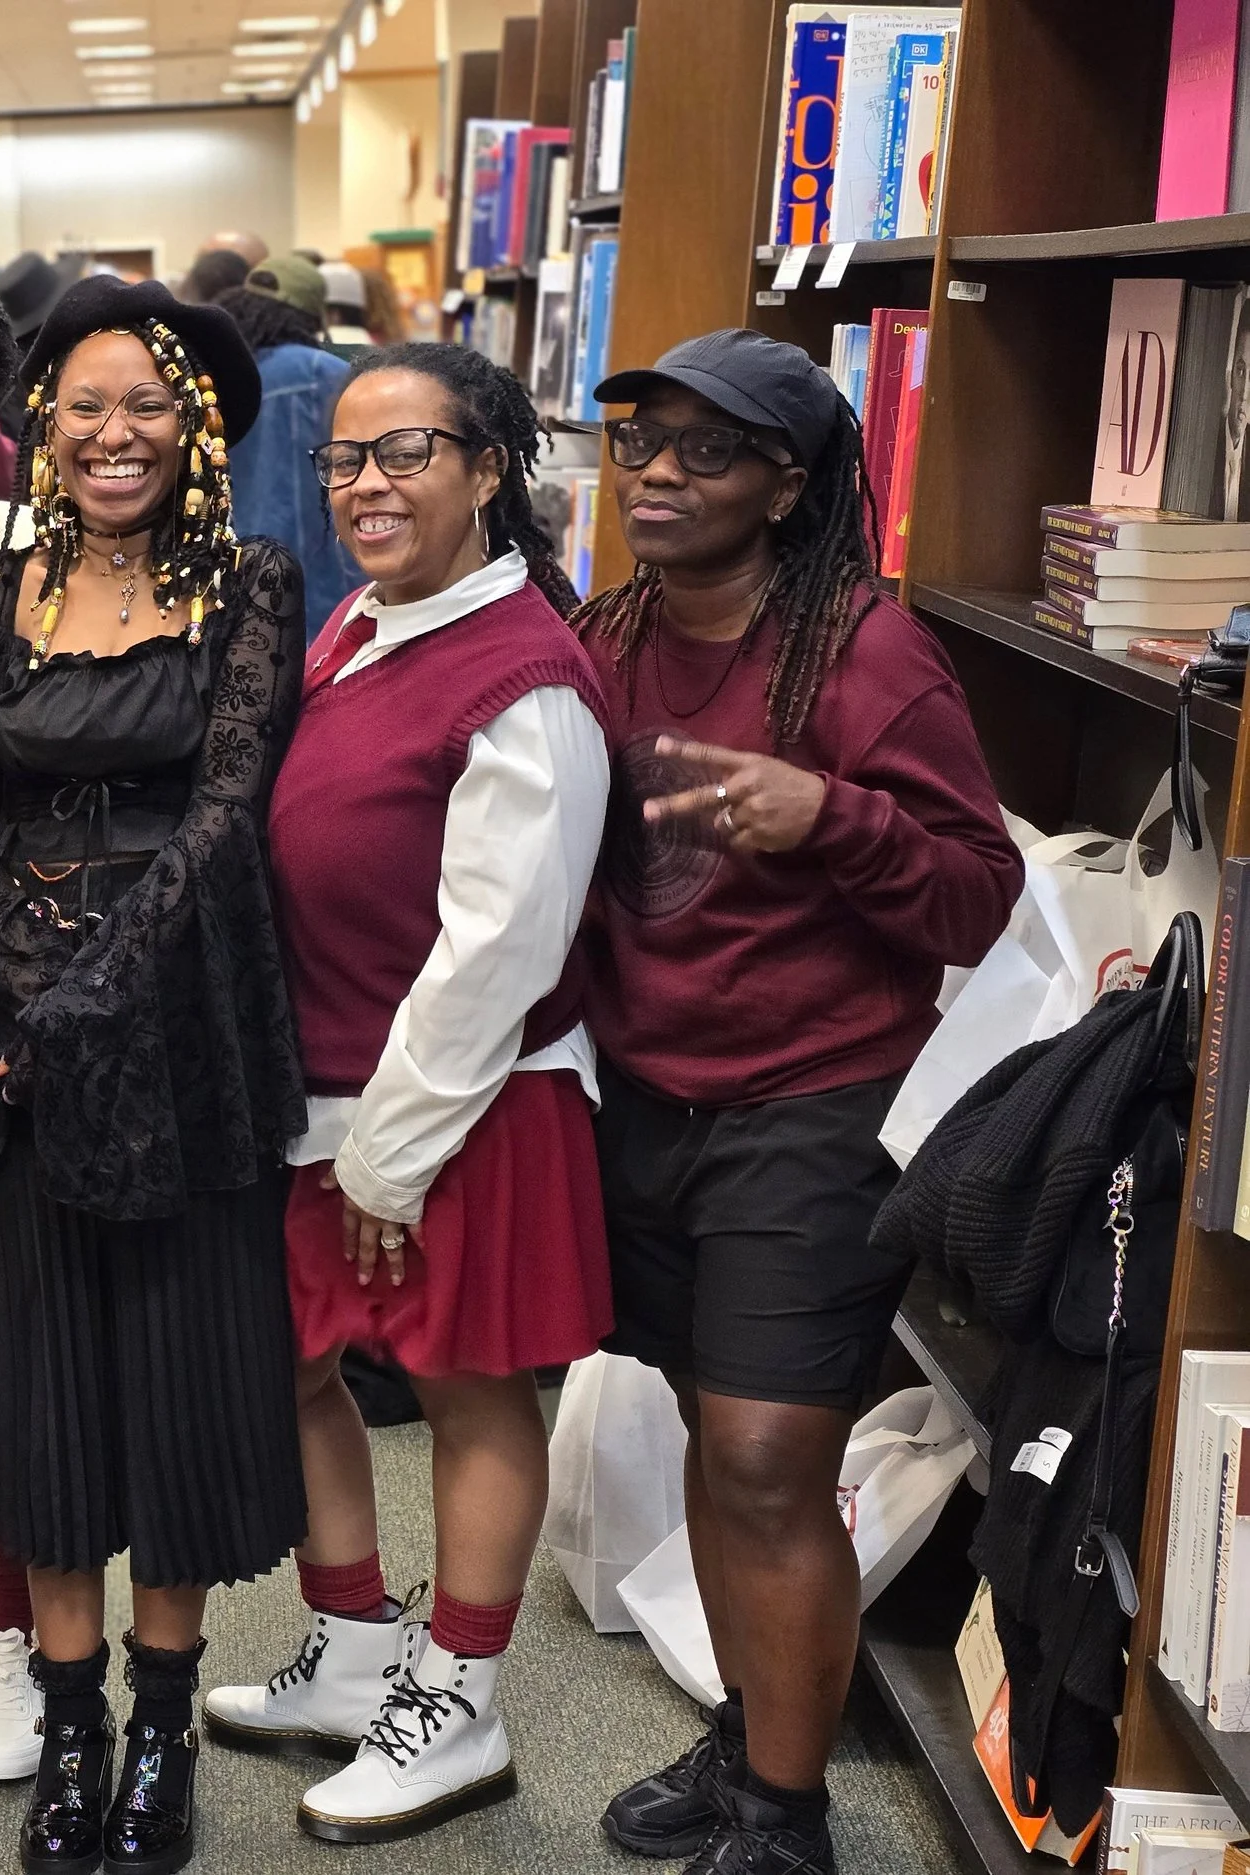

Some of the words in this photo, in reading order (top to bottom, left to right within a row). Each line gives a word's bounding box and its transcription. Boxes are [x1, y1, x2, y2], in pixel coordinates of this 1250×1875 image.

[913, 45, 927, 56] DK
[922, 75, 940, 90] 10
[1097, 328, 1167, 477] AD
[1216, 913, 1234, 986] COLOR
[1207, 988, 1227, 1076] PATTERN
[1197, 1084, 1218, 1176] TEXTURE
[1205, 1436, 1214, 1475] House
[1171, 1470, 1184, 1557] Remodelista
[1202, 1487, 1211, 1516] Love
[1199, 1528, 1208, 1565] Home
[1218, 1577, 1228, 1605] DIY
[1131, 1814, 1170, 1829] THE
